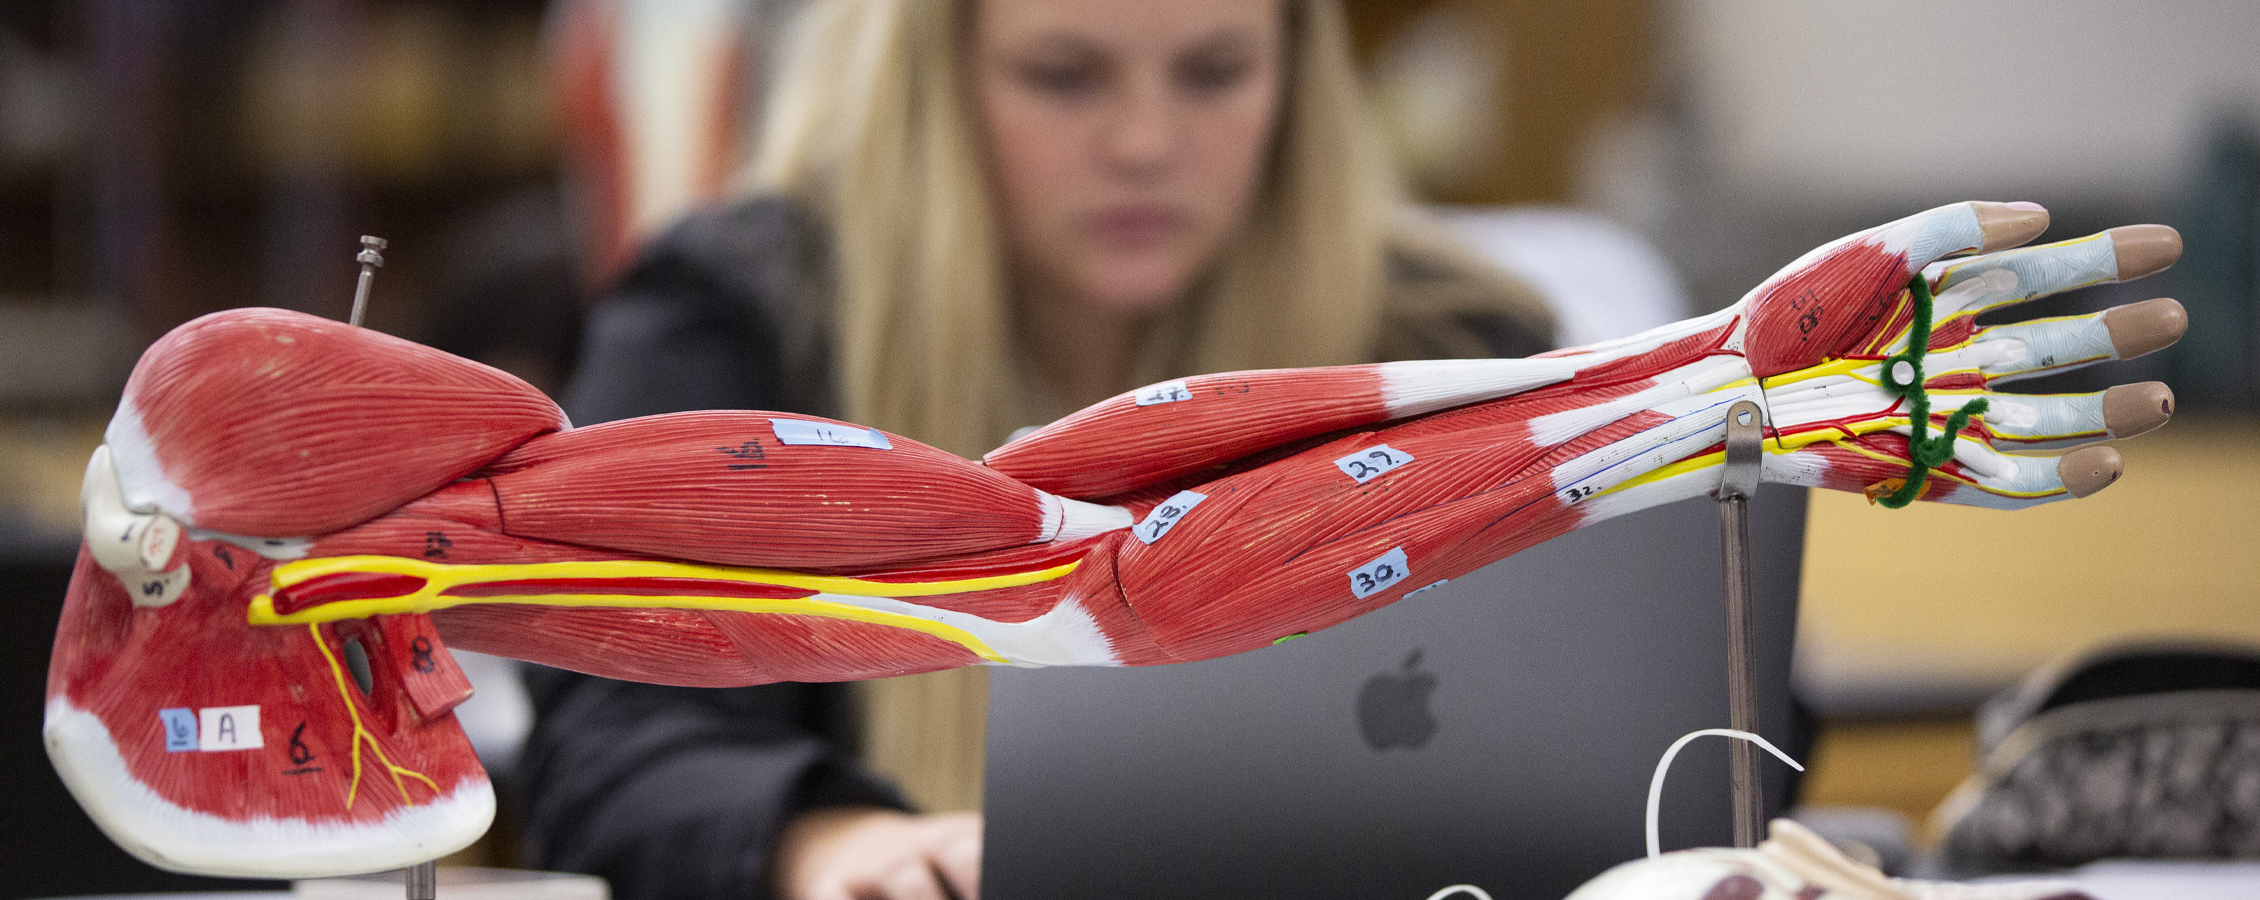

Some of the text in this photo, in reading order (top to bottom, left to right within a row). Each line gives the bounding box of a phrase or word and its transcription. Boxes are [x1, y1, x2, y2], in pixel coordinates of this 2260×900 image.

[1356, 564, 1401, 593] 30.
[219, 713, 236, 743] A
[287, 721, 319, 772] 6
